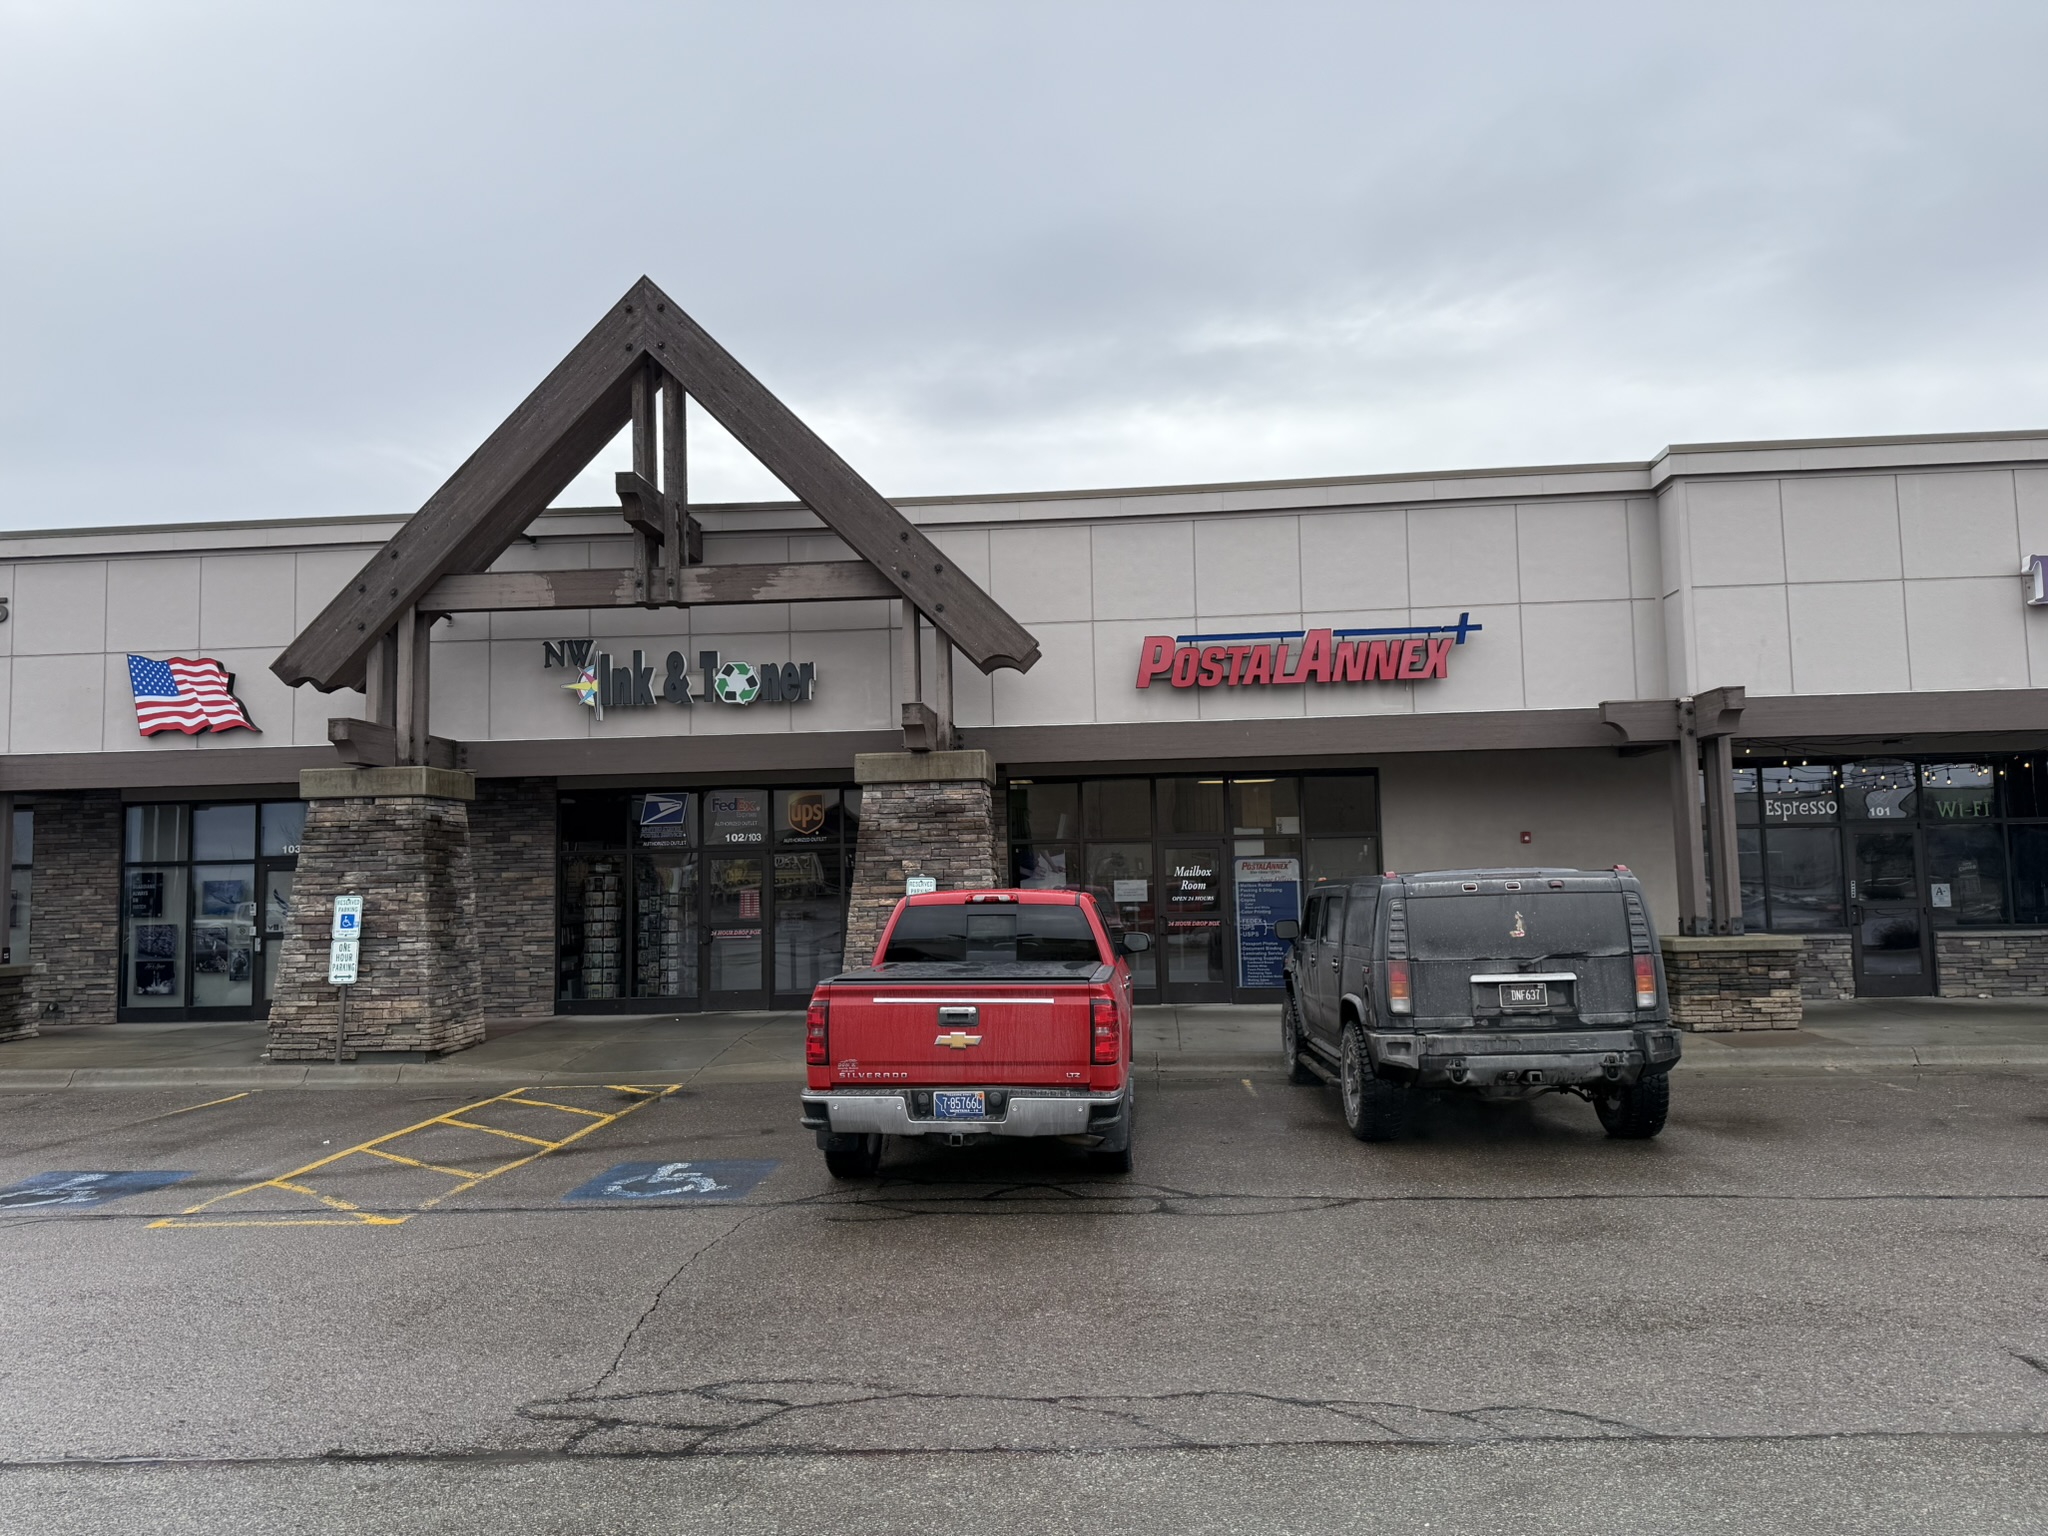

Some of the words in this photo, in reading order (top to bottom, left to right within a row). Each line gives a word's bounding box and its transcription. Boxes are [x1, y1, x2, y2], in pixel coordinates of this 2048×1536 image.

[542, 640, 595, 668] NW
[600, 650, 656, 705] Ink
[664, 651, 693, 704] &
[712, 797, 755, 812] FedEx
[1766, 799, 1838, 821] Espresso
[1936, 800, 1990, 817] Wi-Fi
[791, 803, 822, 828] ups
[1869, 807, 1891, 816] 101
[725, 833, 762, 842] 102/103
[282, 845, 300, 854] 103
[1174, 865, 1212, 877] Mailbox
[1181, 880, 1206, 890] Room
[339, 944, 351, 952] ONE
[332, 963, 355, 971] PARKING
[1511, 989, 1540, 1001] DNF637
